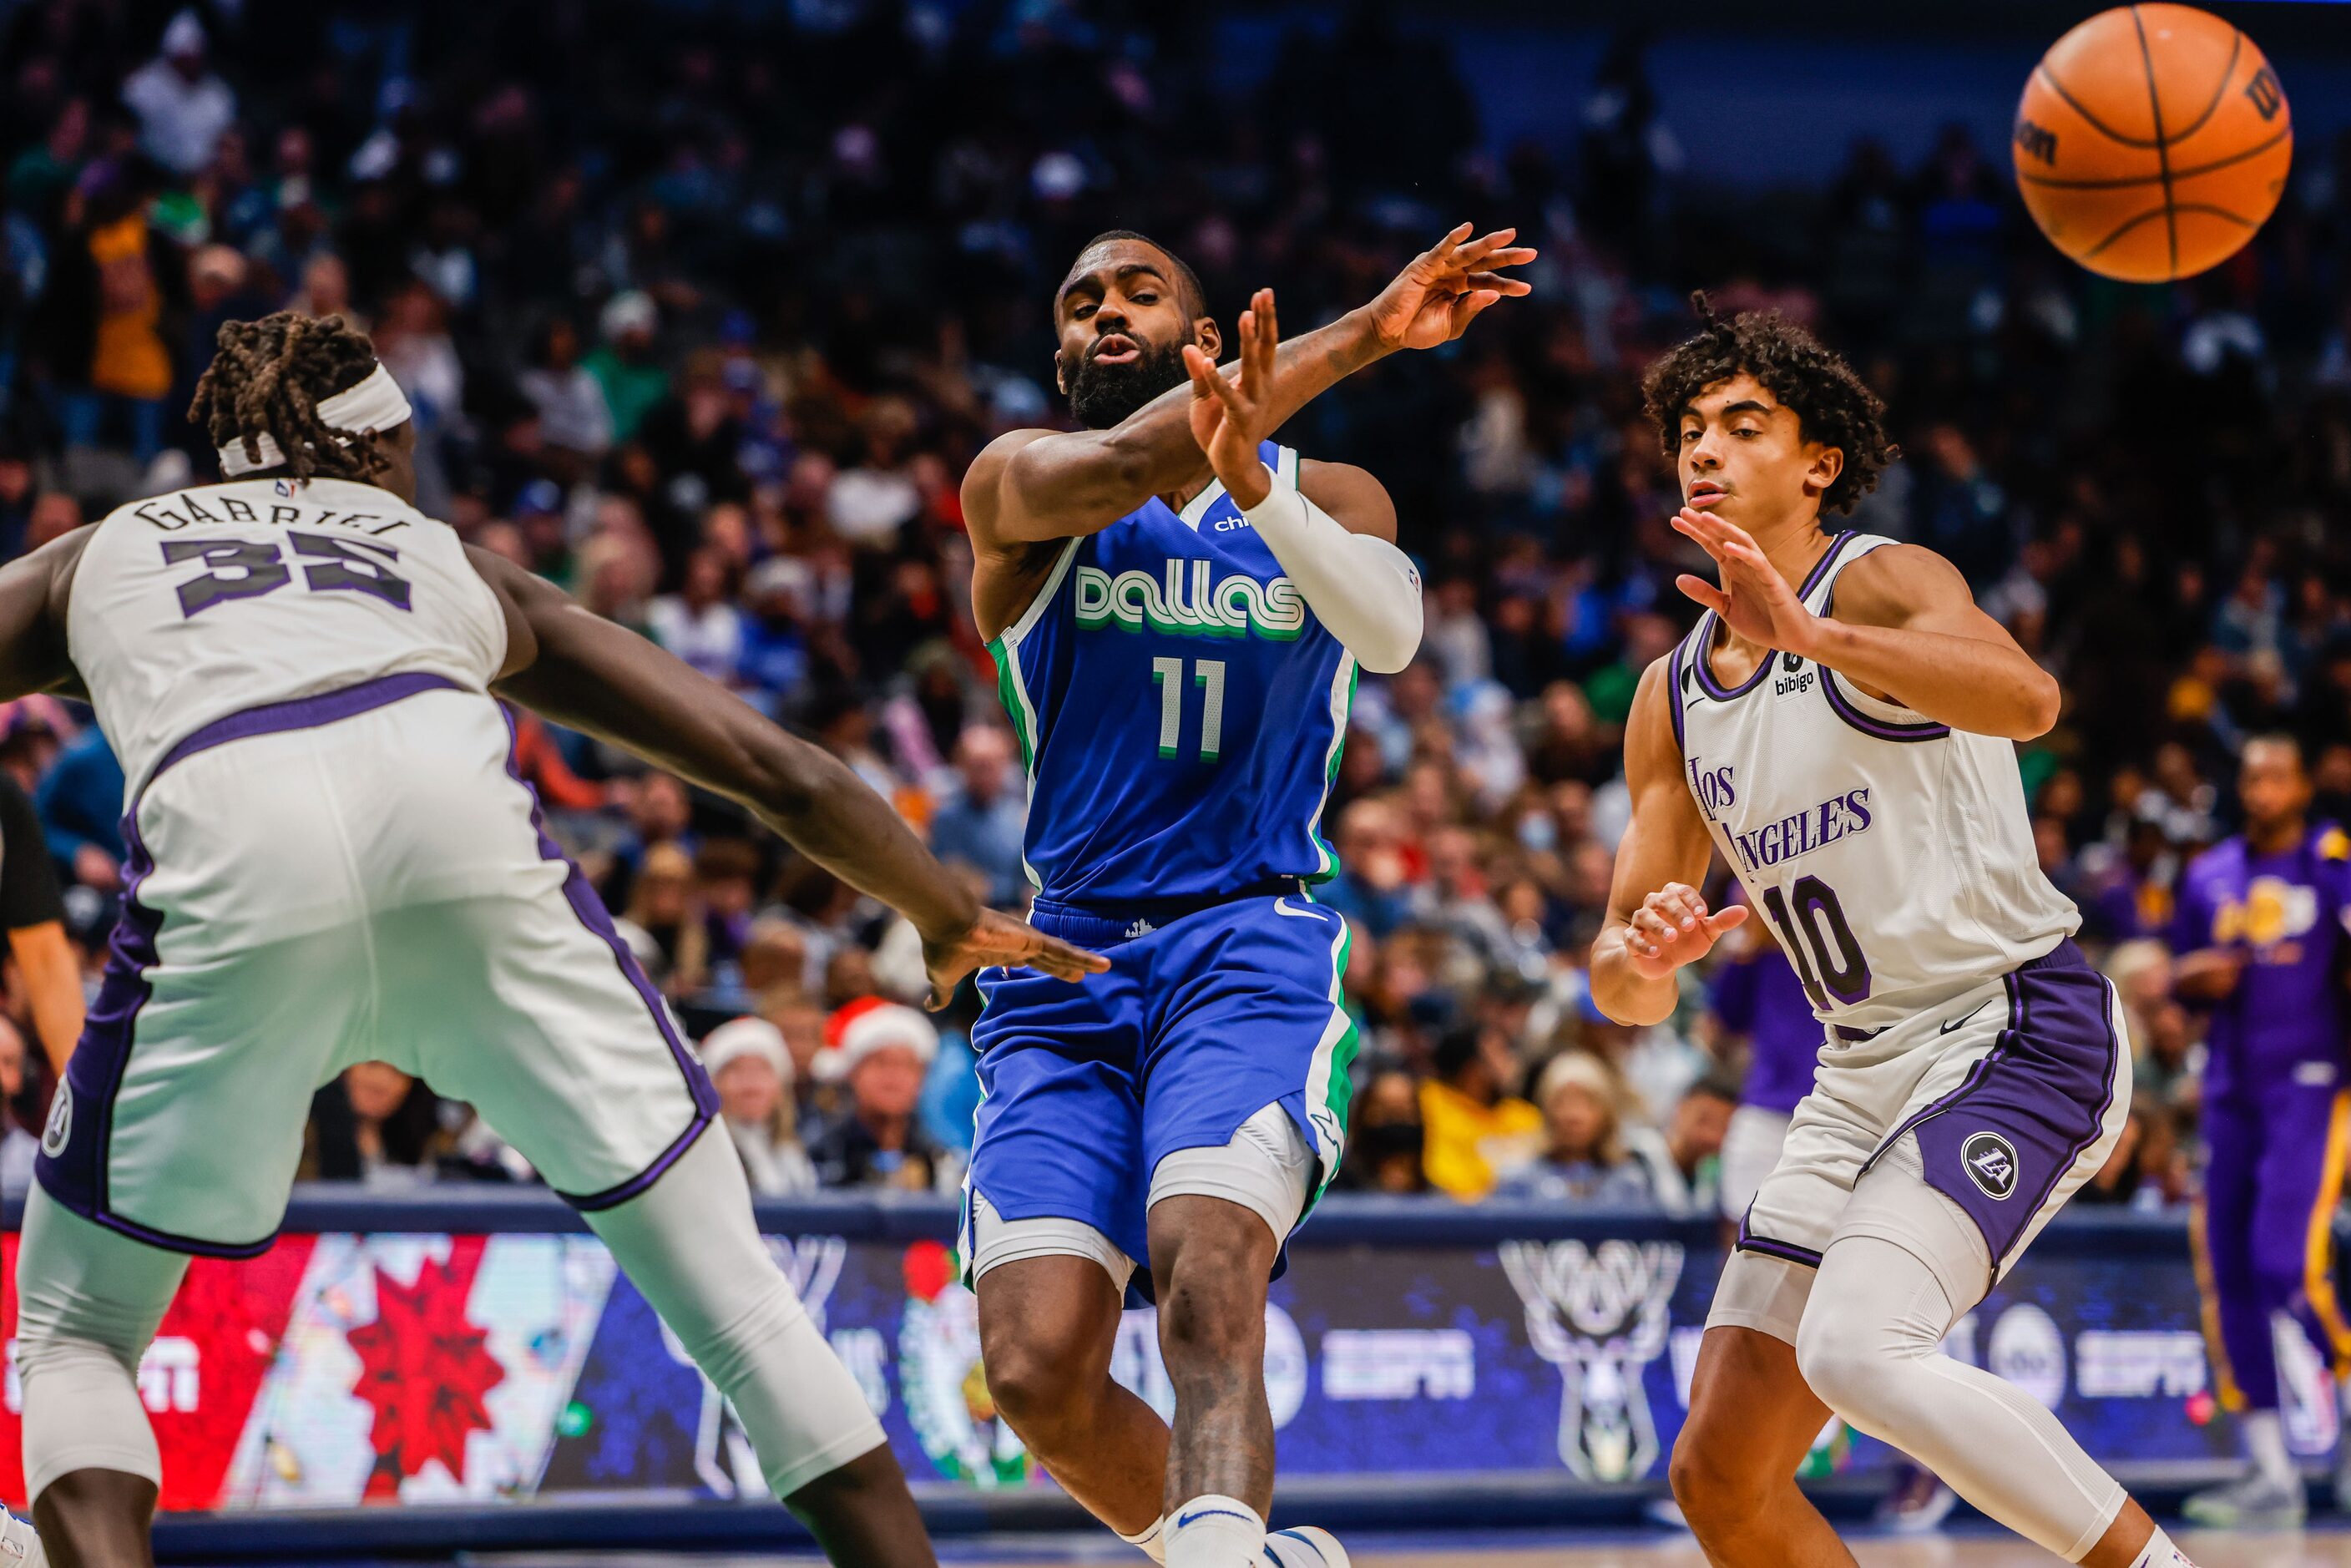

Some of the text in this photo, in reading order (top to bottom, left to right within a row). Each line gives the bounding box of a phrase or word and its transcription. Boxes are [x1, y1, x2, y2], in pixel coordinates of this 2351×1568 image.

[1215, 514, 1249, 532] chi
[159, 529, 413, 620] 35
[1152, 656, 1226, 763] 11
[1775, 672, 1813, 696] bibigo
[1763, 874, 1872, 1011] 10
